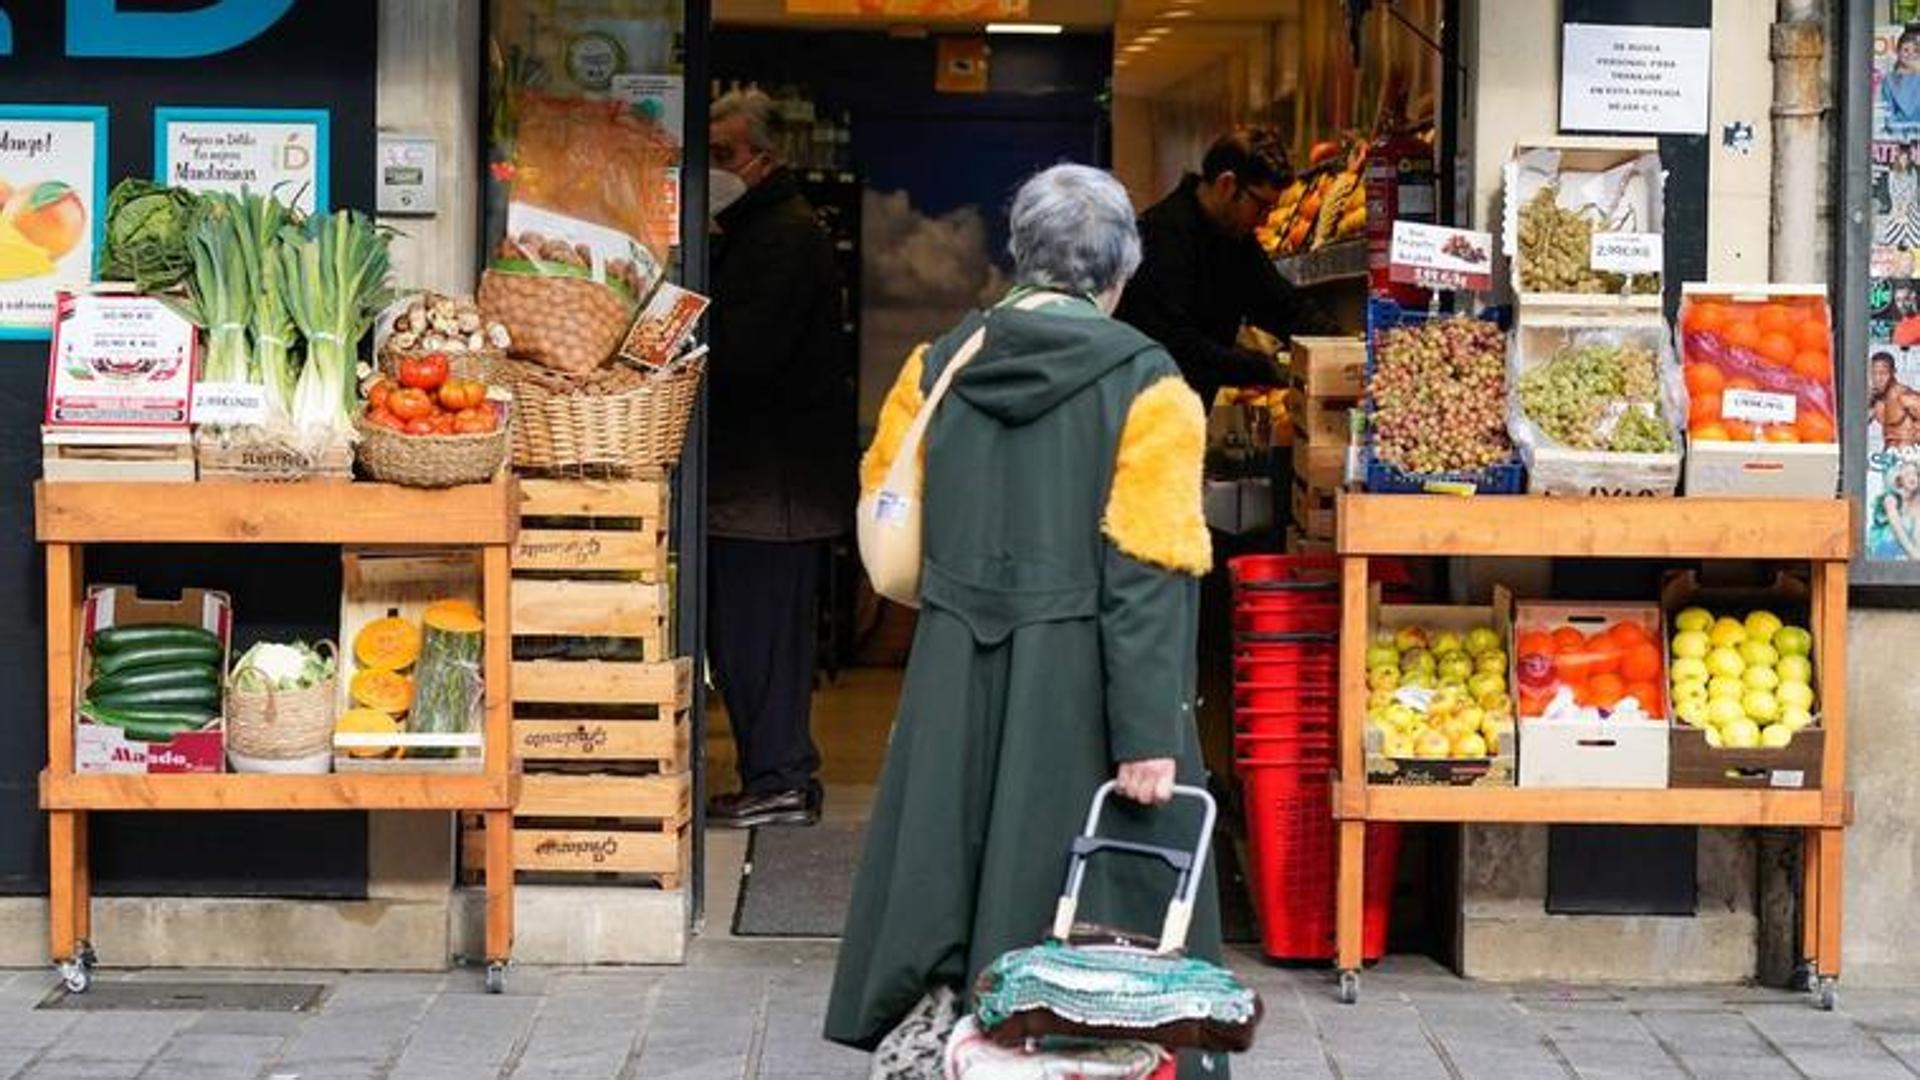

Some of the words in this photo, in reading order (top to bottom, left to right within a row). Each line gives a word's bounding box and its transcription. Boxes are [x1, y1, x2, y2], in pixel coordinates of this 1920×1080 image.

[1628, 43, 1661, 52] BUSCA
[1596, 57, 1647, 67] PERSONAL
[1649, 59, 1676, 68] PARA
[1611, 71, 1662, 80] TRABAJAR
[1590, 87, 1603, 95] EN
[1605, 87, 1630, 96] ESTA
[175, 161, 257, 181] Mandarinas
